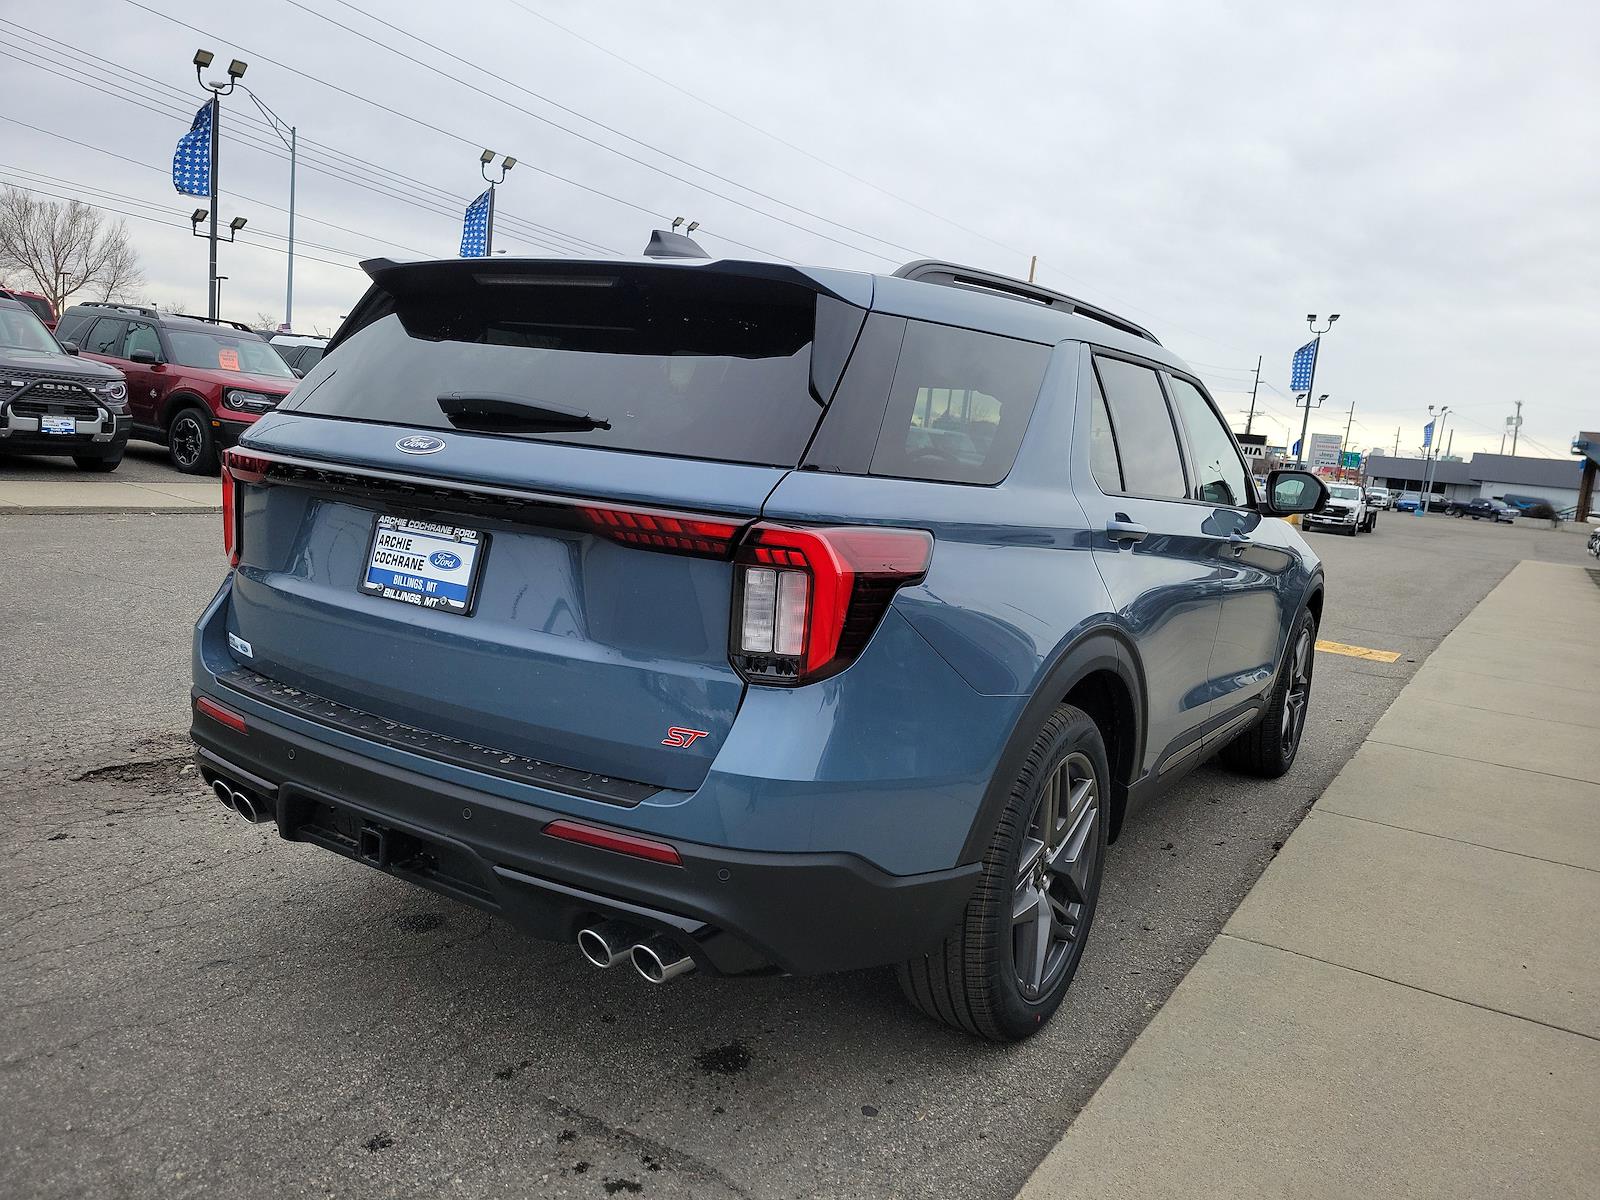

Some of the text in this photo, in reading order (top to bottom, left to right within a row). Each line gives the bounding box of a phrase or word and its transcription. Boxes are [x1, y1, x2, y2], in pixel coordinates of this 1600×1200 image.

[378, 515, 477, 539] ARCHIE COCHRANE FORD
[378, 534, 413, 551] ARCHIE
[374, 551, 425, 571] COCHRANE
[434, 552, 456, 568] Ford
[393, 574, 438, 593] BILLINGS, MT
[382, 587, 439, 608] BILLINGS, MT
[661, 726, 710, 748] ST
